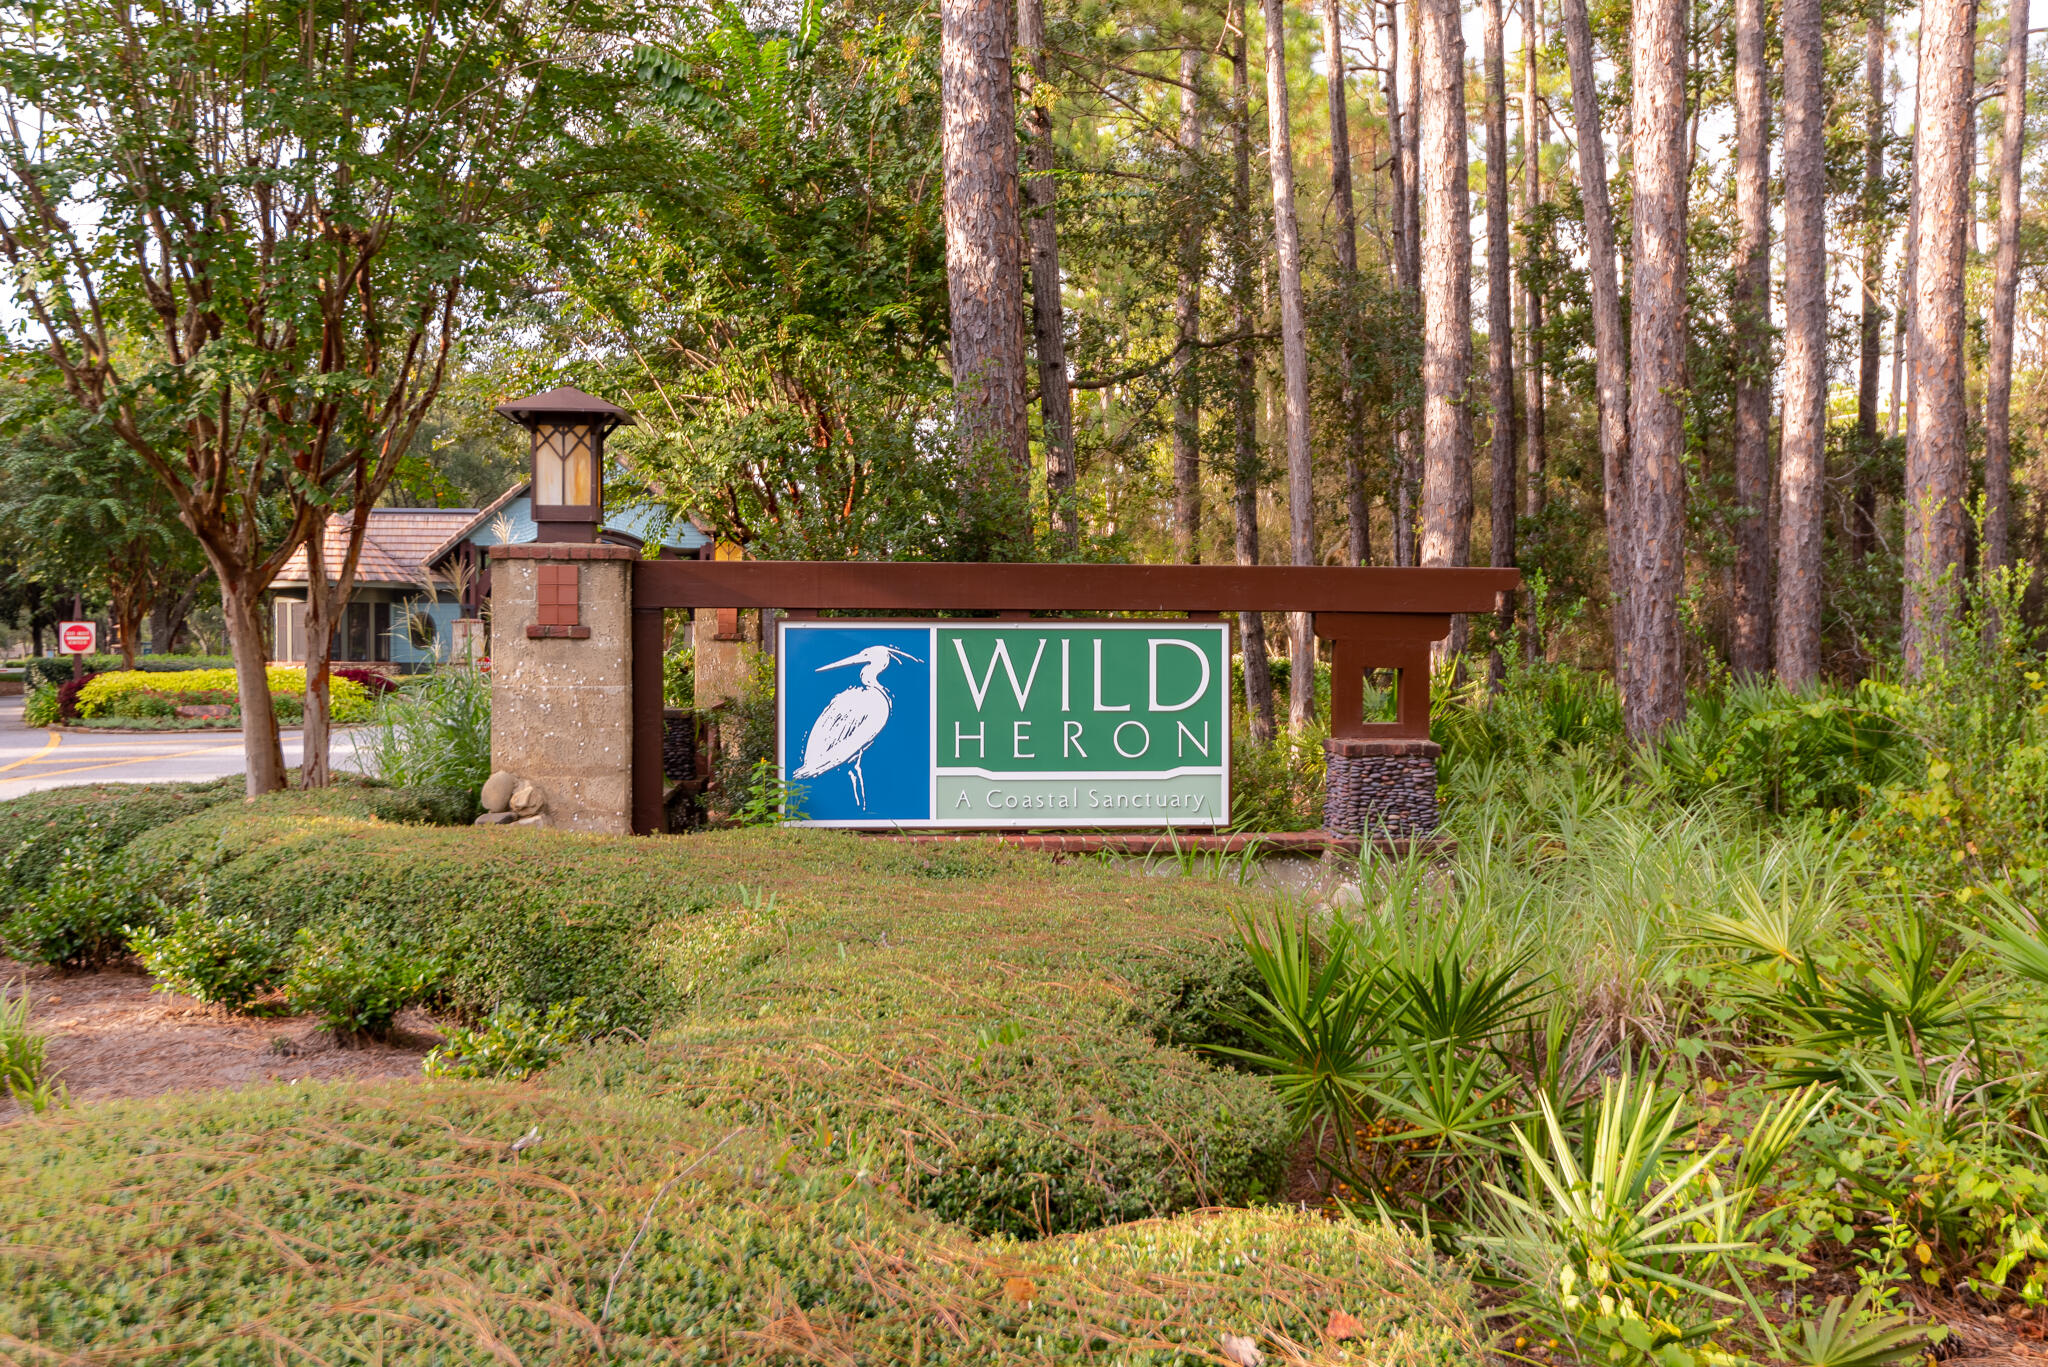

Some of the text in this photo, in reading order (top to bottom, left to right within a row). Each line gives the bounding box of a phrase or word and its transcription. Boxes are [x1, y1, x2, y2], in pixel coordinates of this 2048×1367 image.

[951, 638, 1211, 713] WILD
[954, 720, 1209, 759] HERON
[954, 786, 1206, 813] A Coastal Sanctuary
